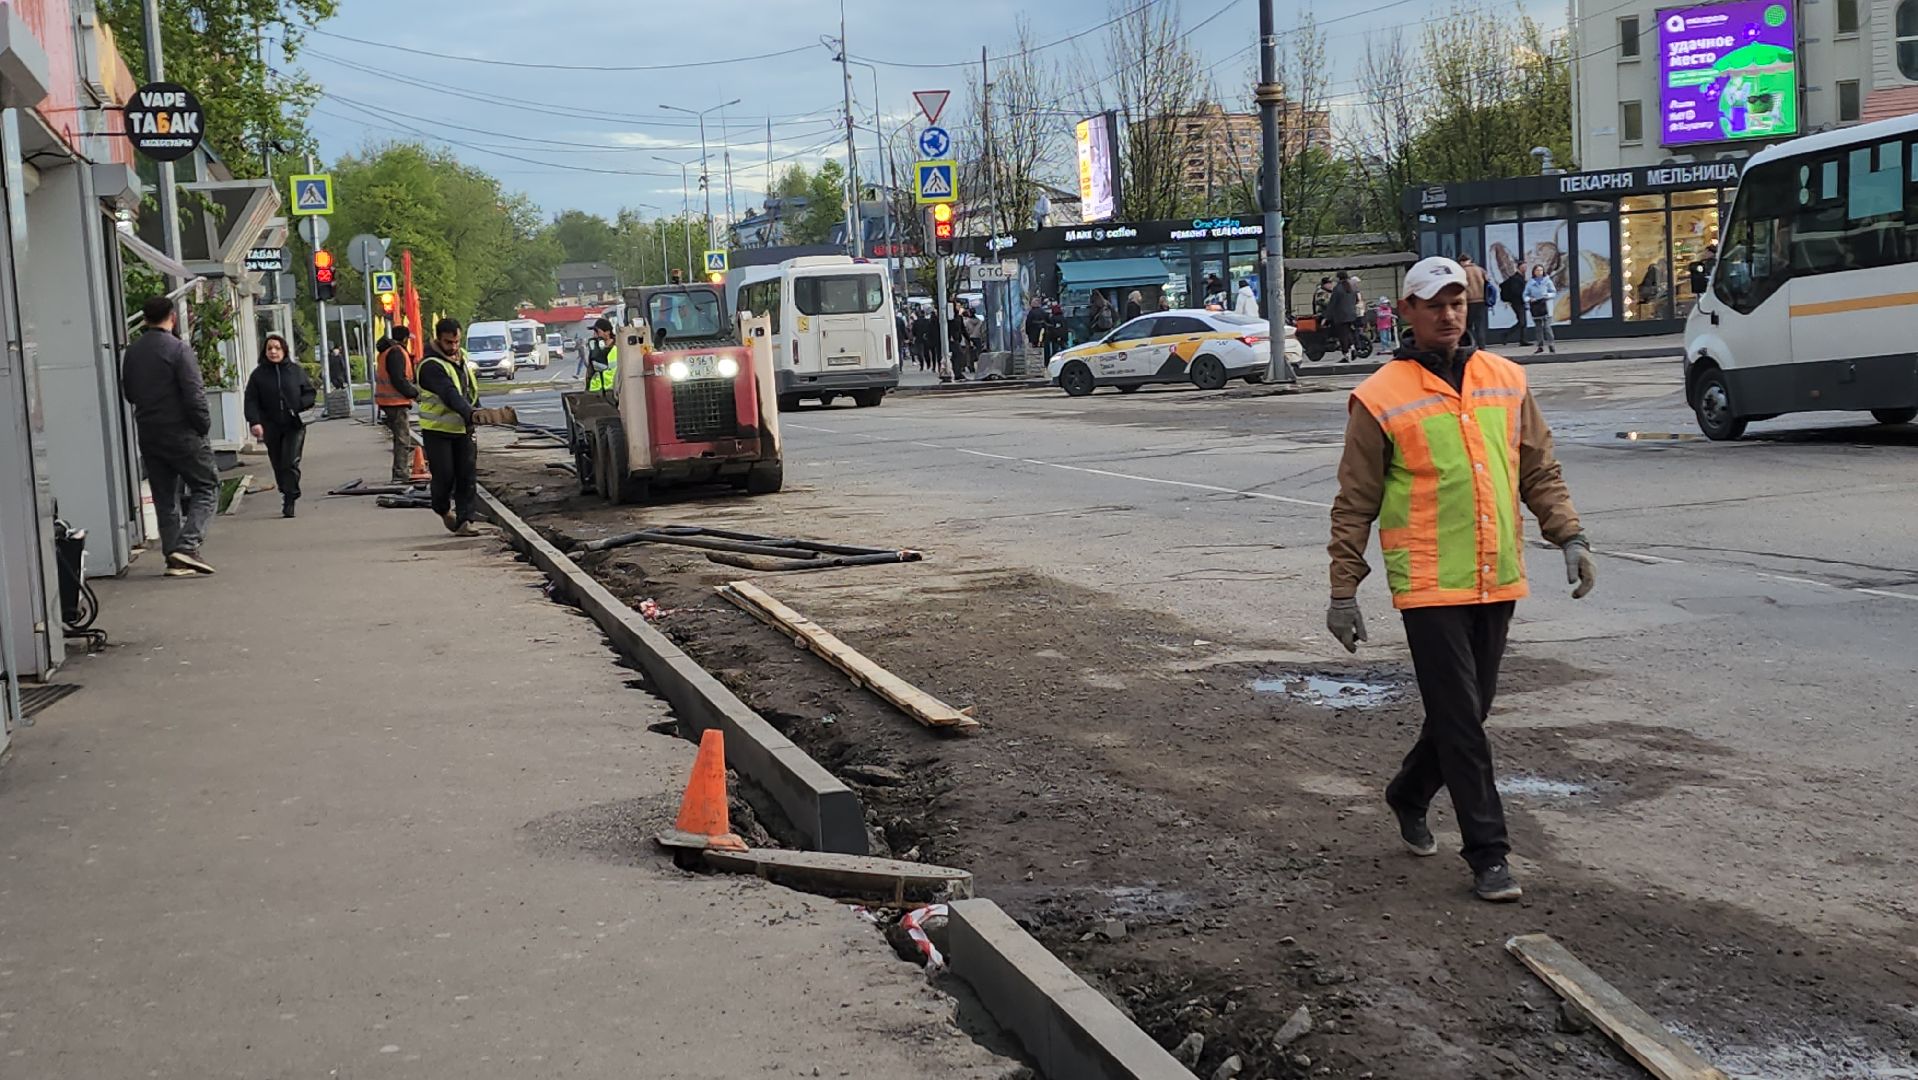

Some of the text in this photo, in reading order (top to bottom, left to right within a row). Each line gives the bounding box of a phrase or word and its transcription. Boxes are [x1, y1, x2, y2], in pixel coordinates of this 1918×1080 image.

[1669, 53, 1716, 66] место
[140, 92, 186, 107] VAPE
[129, 112, 199, 133] ТАБАК
[1560, 163, 1738, 192] ПЕКАРНЯ МЕЛЬНИЦА
